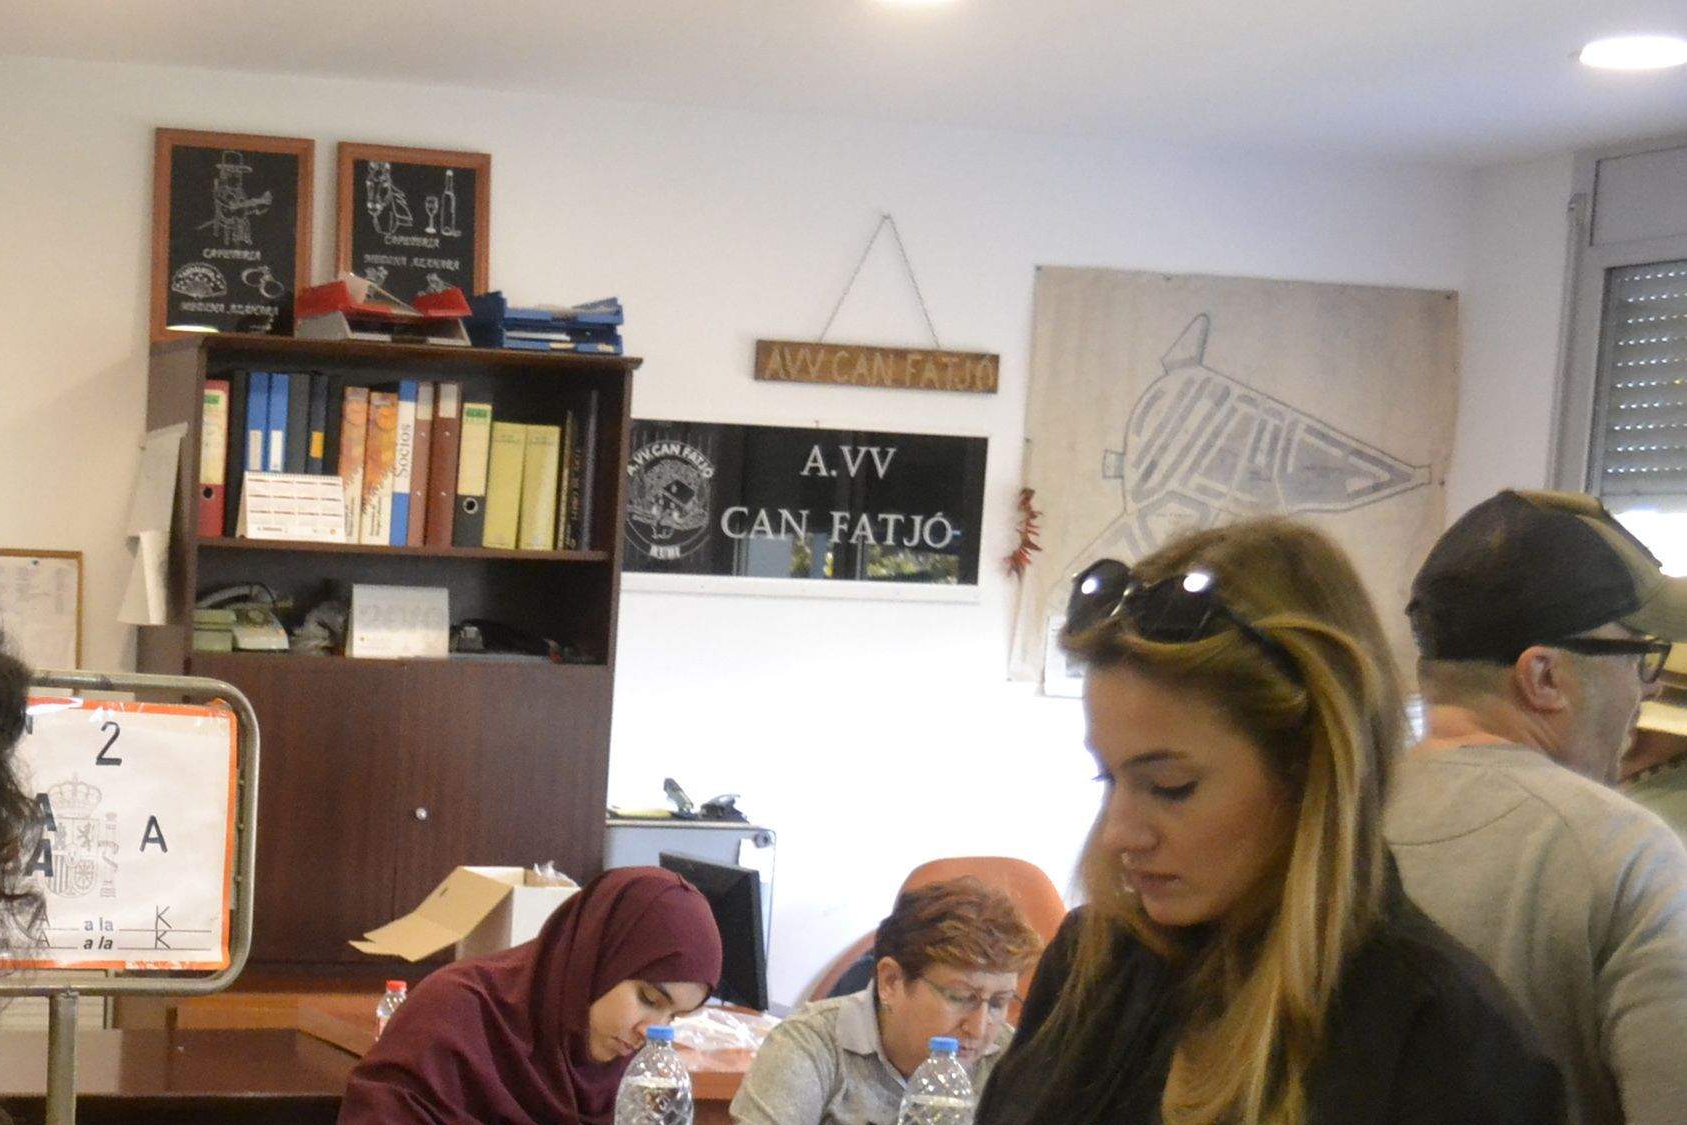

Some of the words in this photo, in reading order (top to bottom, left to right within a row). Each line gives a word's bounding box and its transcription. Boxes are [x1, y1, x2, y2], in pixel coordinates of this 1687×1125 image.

[832, 351, 893, 387] CAN
[799, 444, 897, 480] A.VV
[720, 505, 810, 553] CAN
[829, 511, 954, 549] FATJÓ
[96, 721, 123, 766] 2
[139, 815, 169, 853] A
[84, 920, 93, 932] a
[99, 917, 113, 932] la
[154, 905, 173, 931] K
[83, 938, 93, 950] a
[98, 936, 114, 950] la
[154, 930, 172, 949] K
